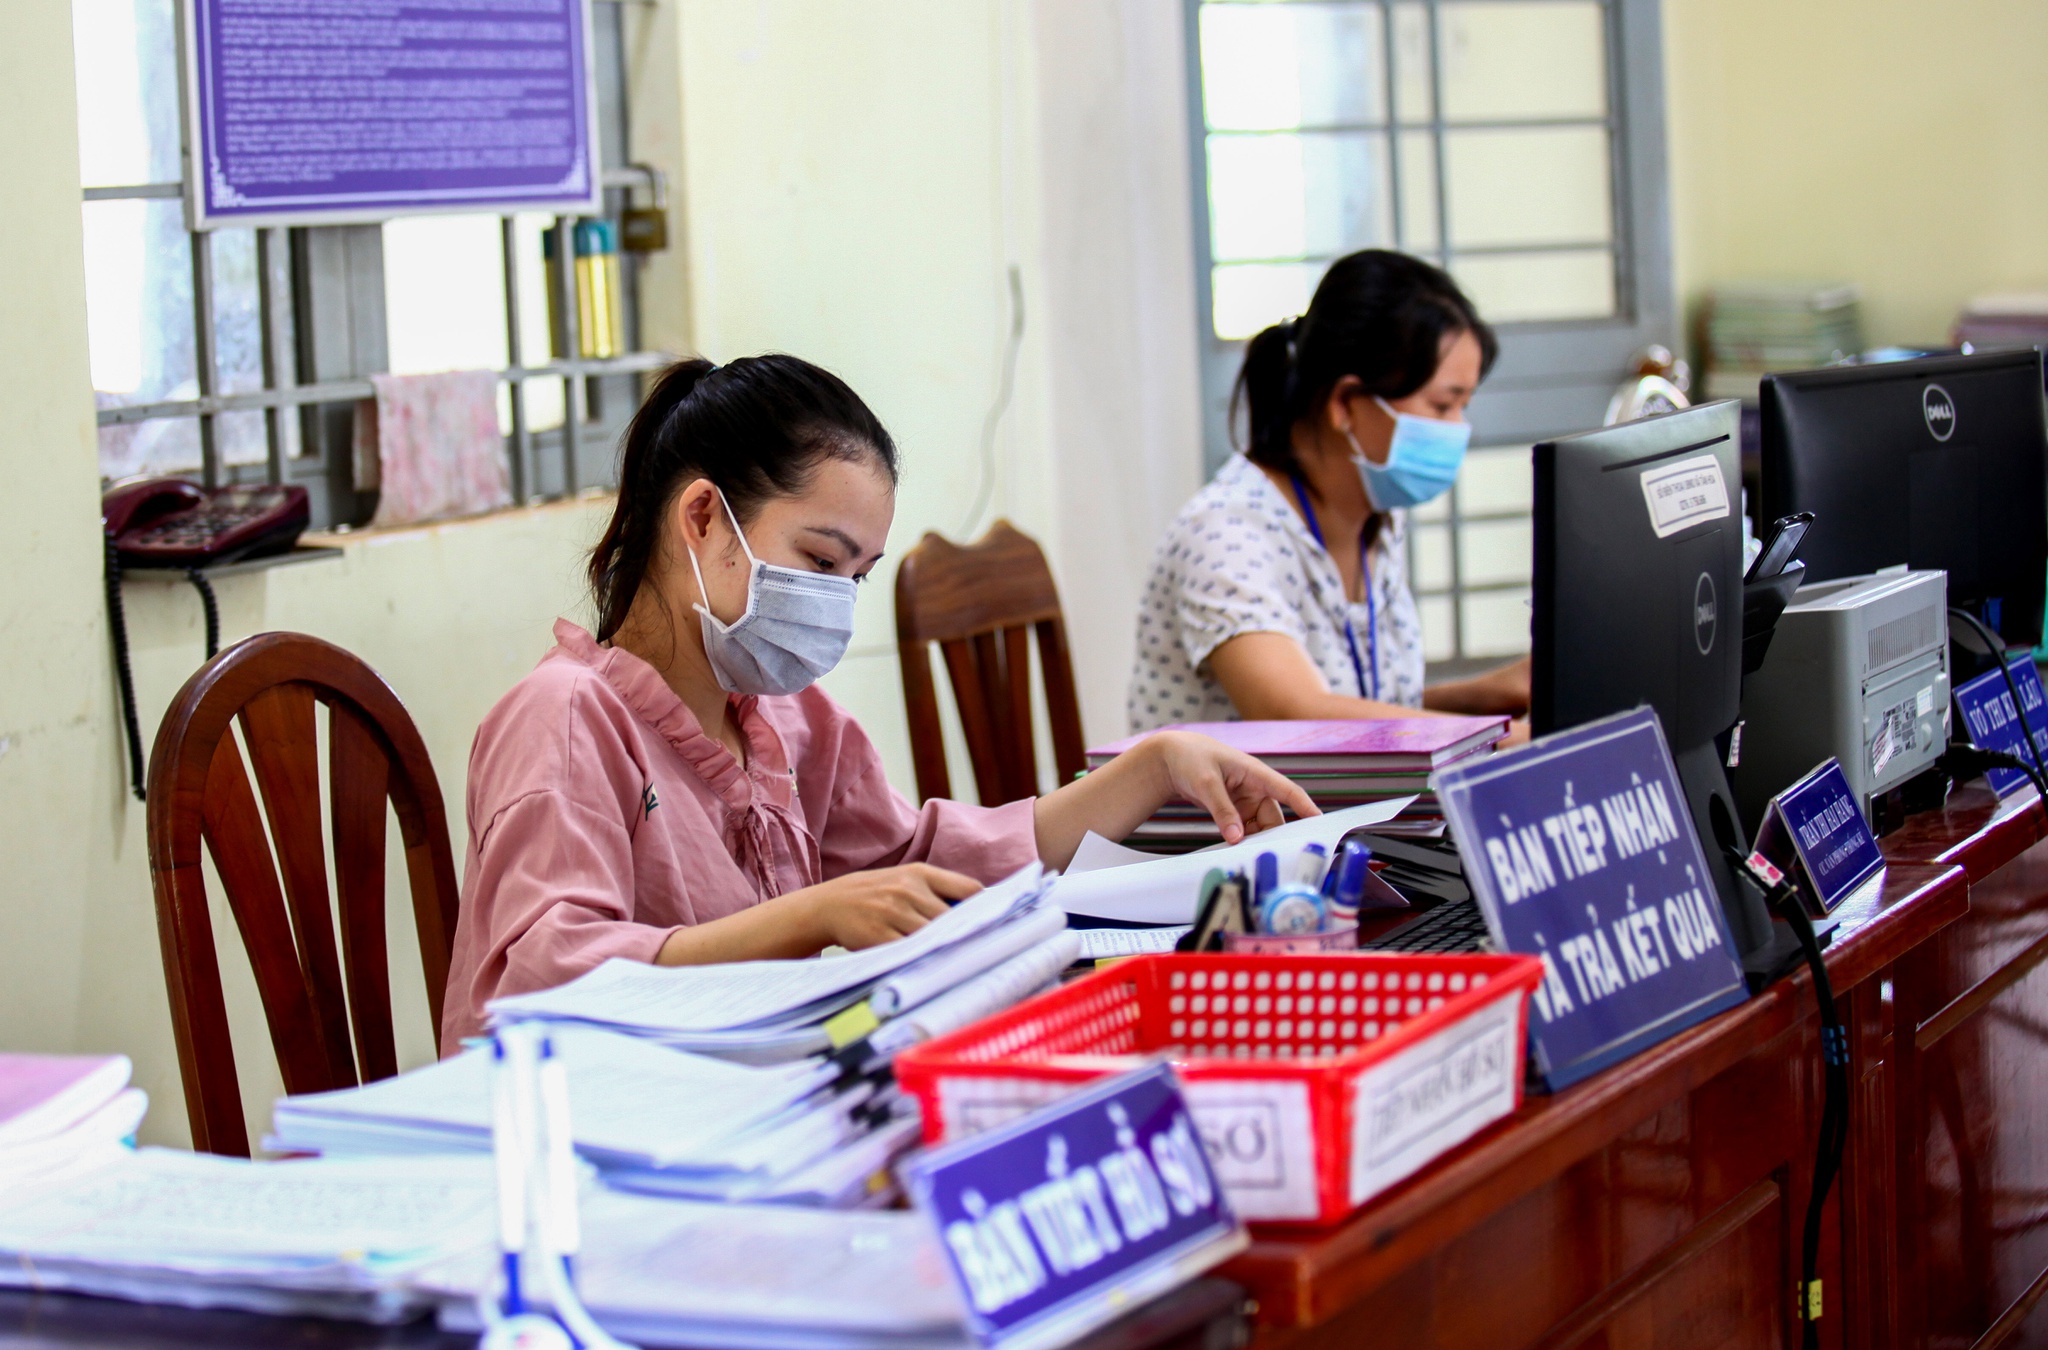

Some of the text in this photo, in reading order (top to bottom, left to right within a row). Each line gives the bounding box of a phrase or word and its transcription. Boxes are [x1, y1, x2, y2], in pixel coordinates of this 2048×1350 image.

[1486, 772, 1680, 905] BÀN TIẾP NHẬN
[1559, 904, 1626, 1005] TRẢ
[1612, 884, 1671, 983] KẾT
[1664, 864, 1722, 961] QUẢ
